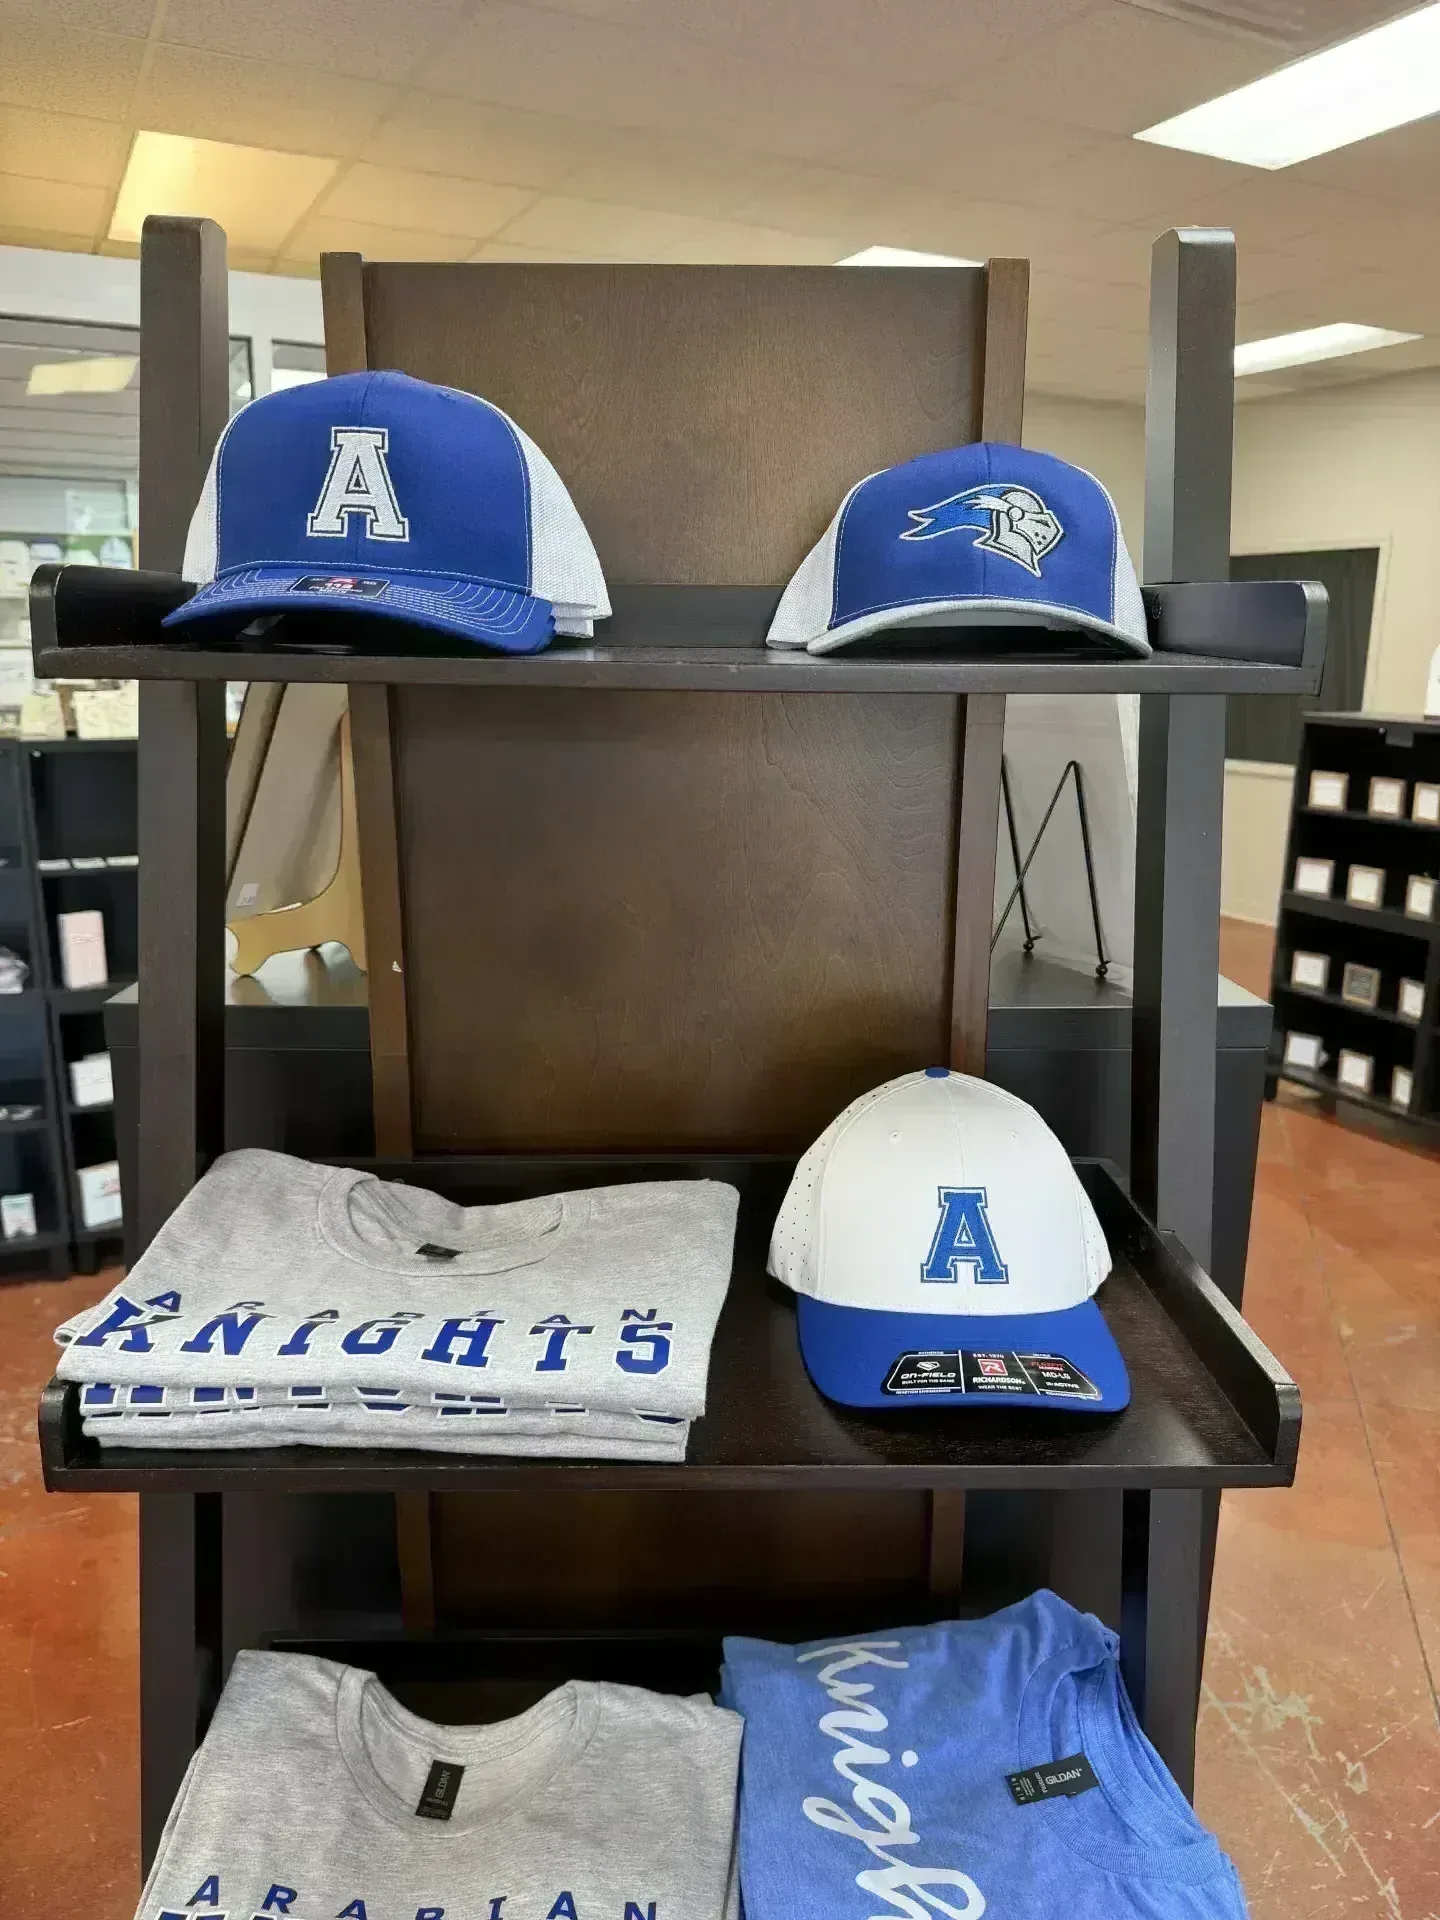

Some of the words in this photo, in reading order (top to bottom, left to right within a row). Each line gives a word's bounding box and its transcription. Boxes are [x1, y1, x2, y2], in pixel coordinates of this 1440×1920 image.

[306, 426, 410, 542] A
[920, 1186, 1009, 1284] A
[71, 1295, 676, 1376] KNIGHTS
[436, 1769, 451, 1798] GILDAN
[1045, 1768, 1082, 1785] GILDAN
